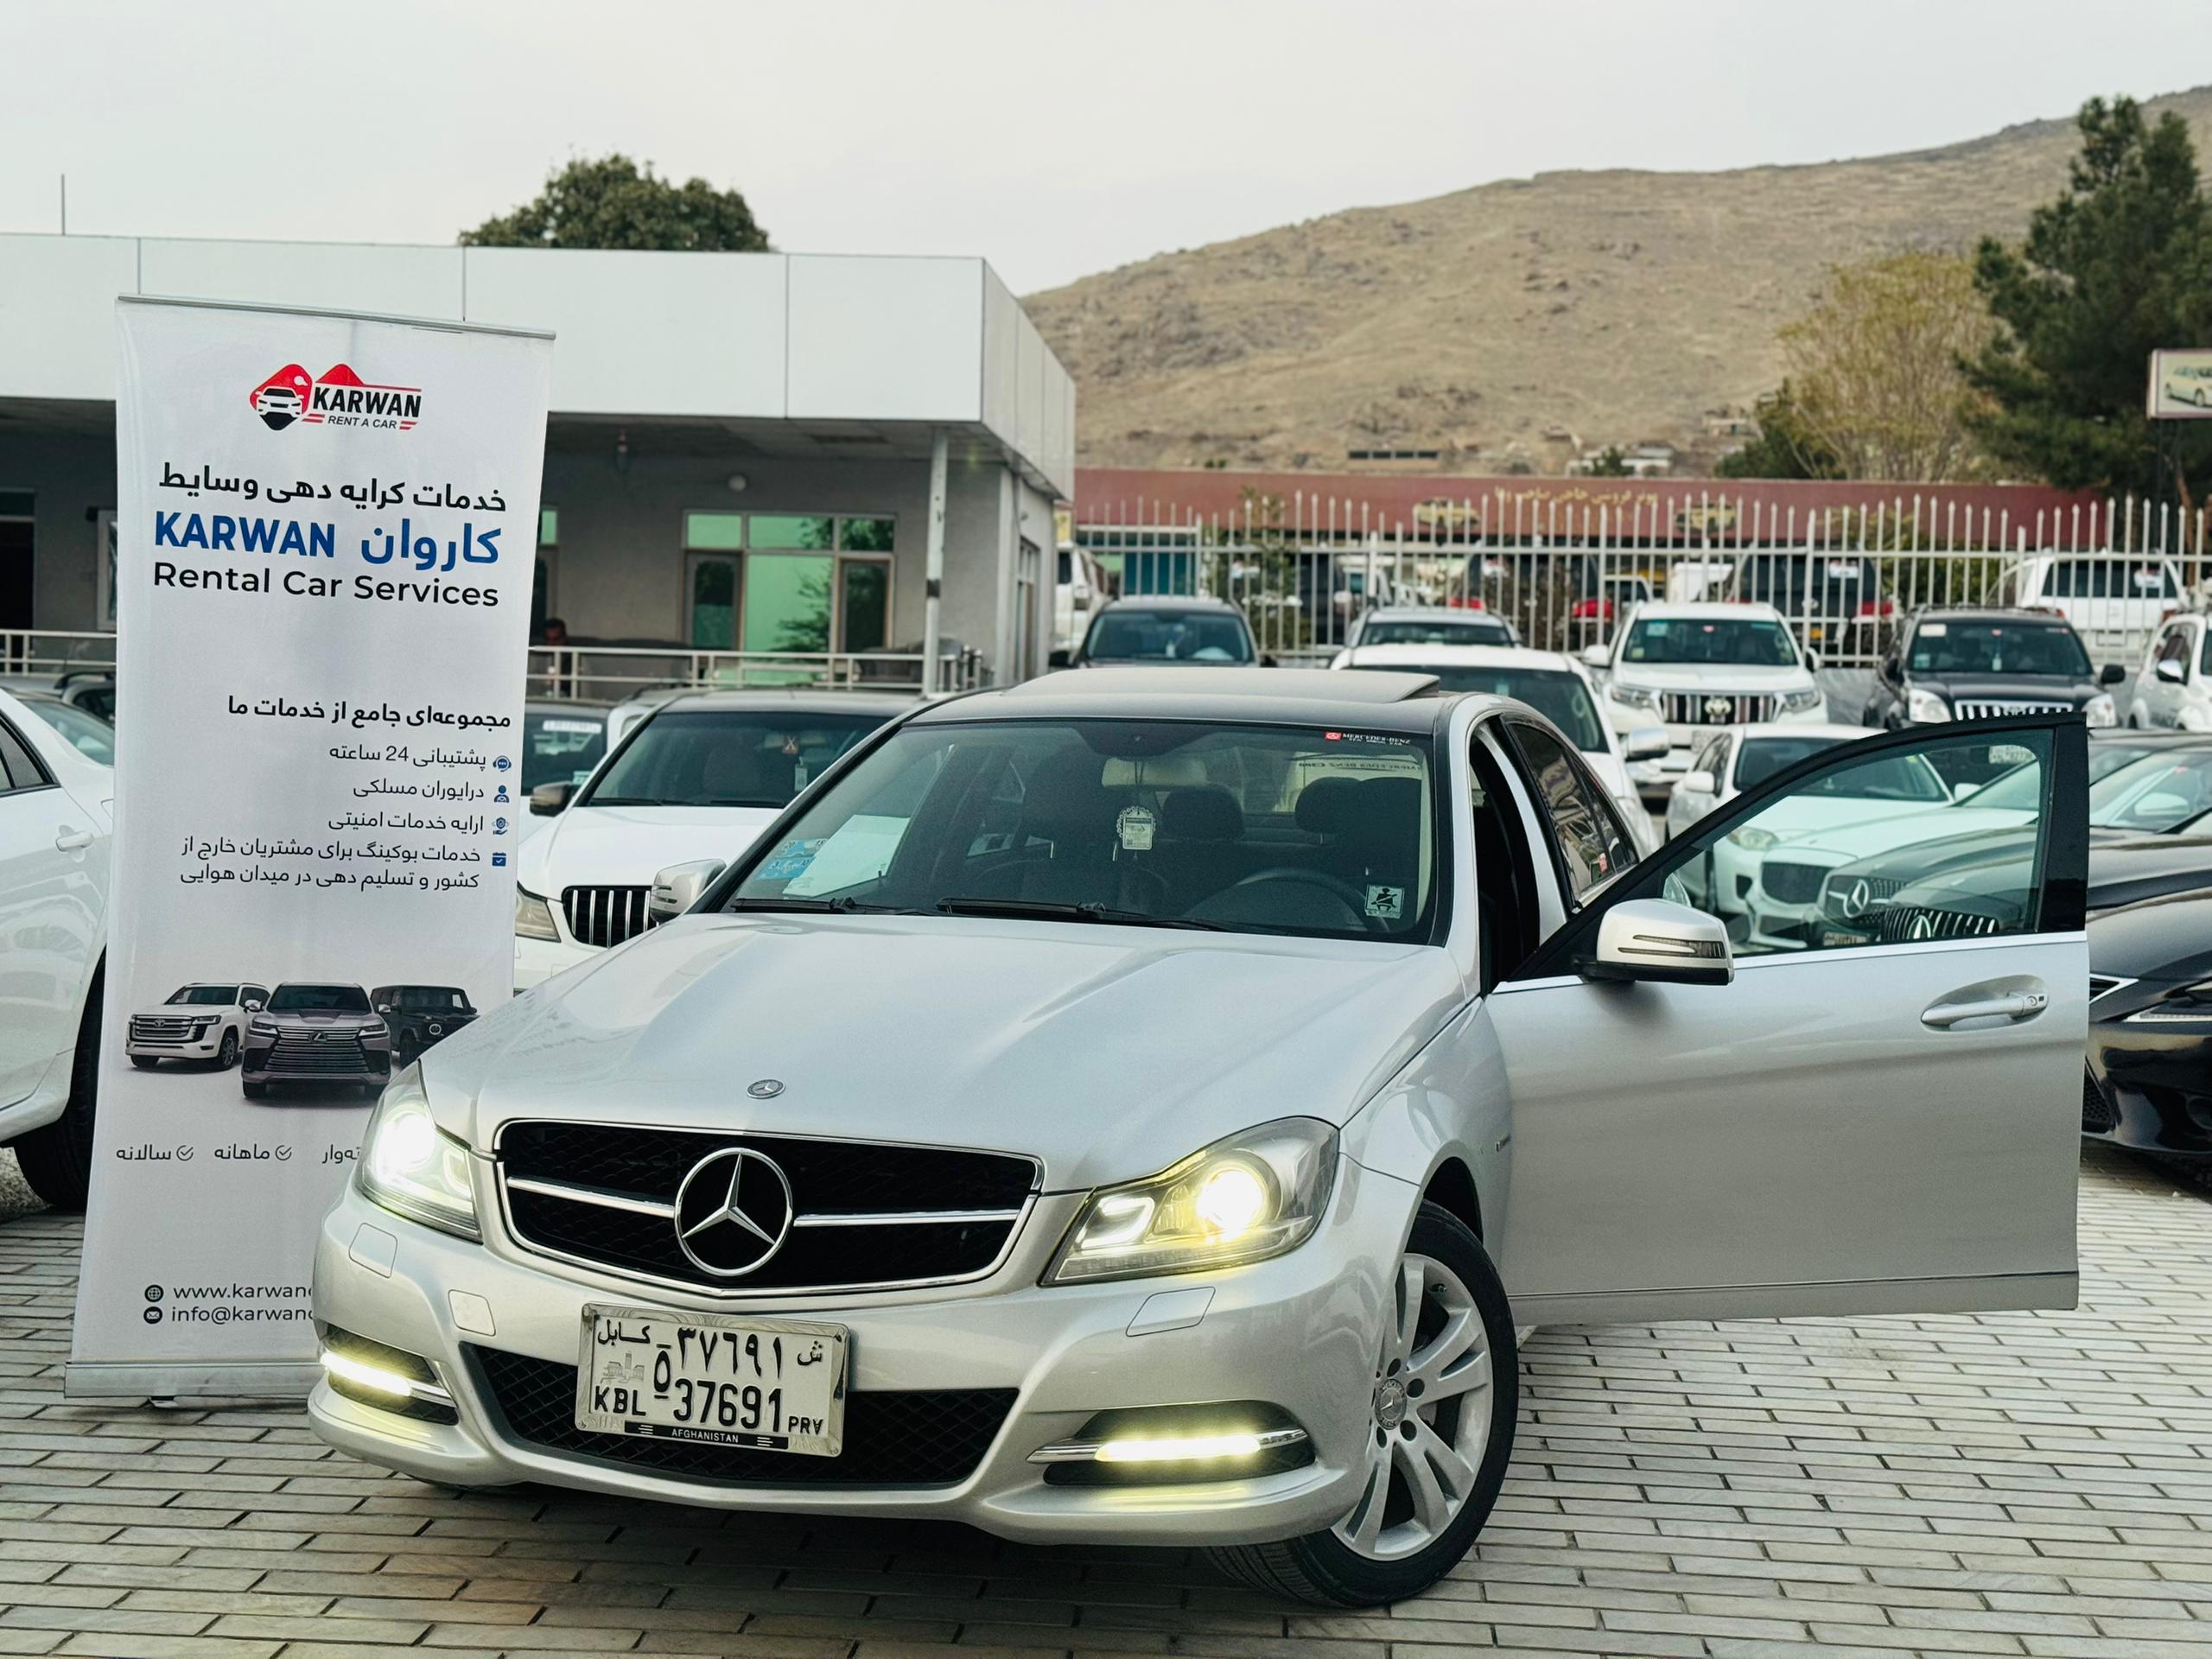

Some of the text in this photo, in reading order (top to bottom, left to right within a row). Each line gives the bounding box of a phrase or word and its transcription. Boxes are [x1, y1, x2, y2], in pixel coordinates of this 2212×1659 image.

[314, 387, 422, 417] KARWAN
[328, 416, 397, 429] RENT A CAR
[159, 462, 505, 512] خدمات کرایه دهی وسایط
[156, 512, 334, 557] KARWAN
[361, 518, 501, 571] کاروان
[155, 562, 498, 607] Rental Car Services
[229, 696, 248, 714] ما
[255, 698, 324, 718] خدمات
[332, 702, 346, 723] از
[352, 703, 400, 728] جامع
[330, 744, 486, 771] پشتیبانی 24 ساعته
[353, 779, 484, 801] درایوران مسلکی
[328, 811, 483, 835] ارایه خدمات امنیتی
[181, 836, 480, 862] خدمات بوکینگ برای مشتریان خارج از
[181, 863, 479, 892] کشور و تسلیم دهی در میدان هوایی
[117, 1144, 171, 1160] سالانه
[214, 1144, 270, 1159] ماهانه
[597, 1319, 650, 1347] کابل
[594, 1379, 823, 1434] KBL 37691 PRV
[671, 1428, 739, 1444] AFGHANISTAN
